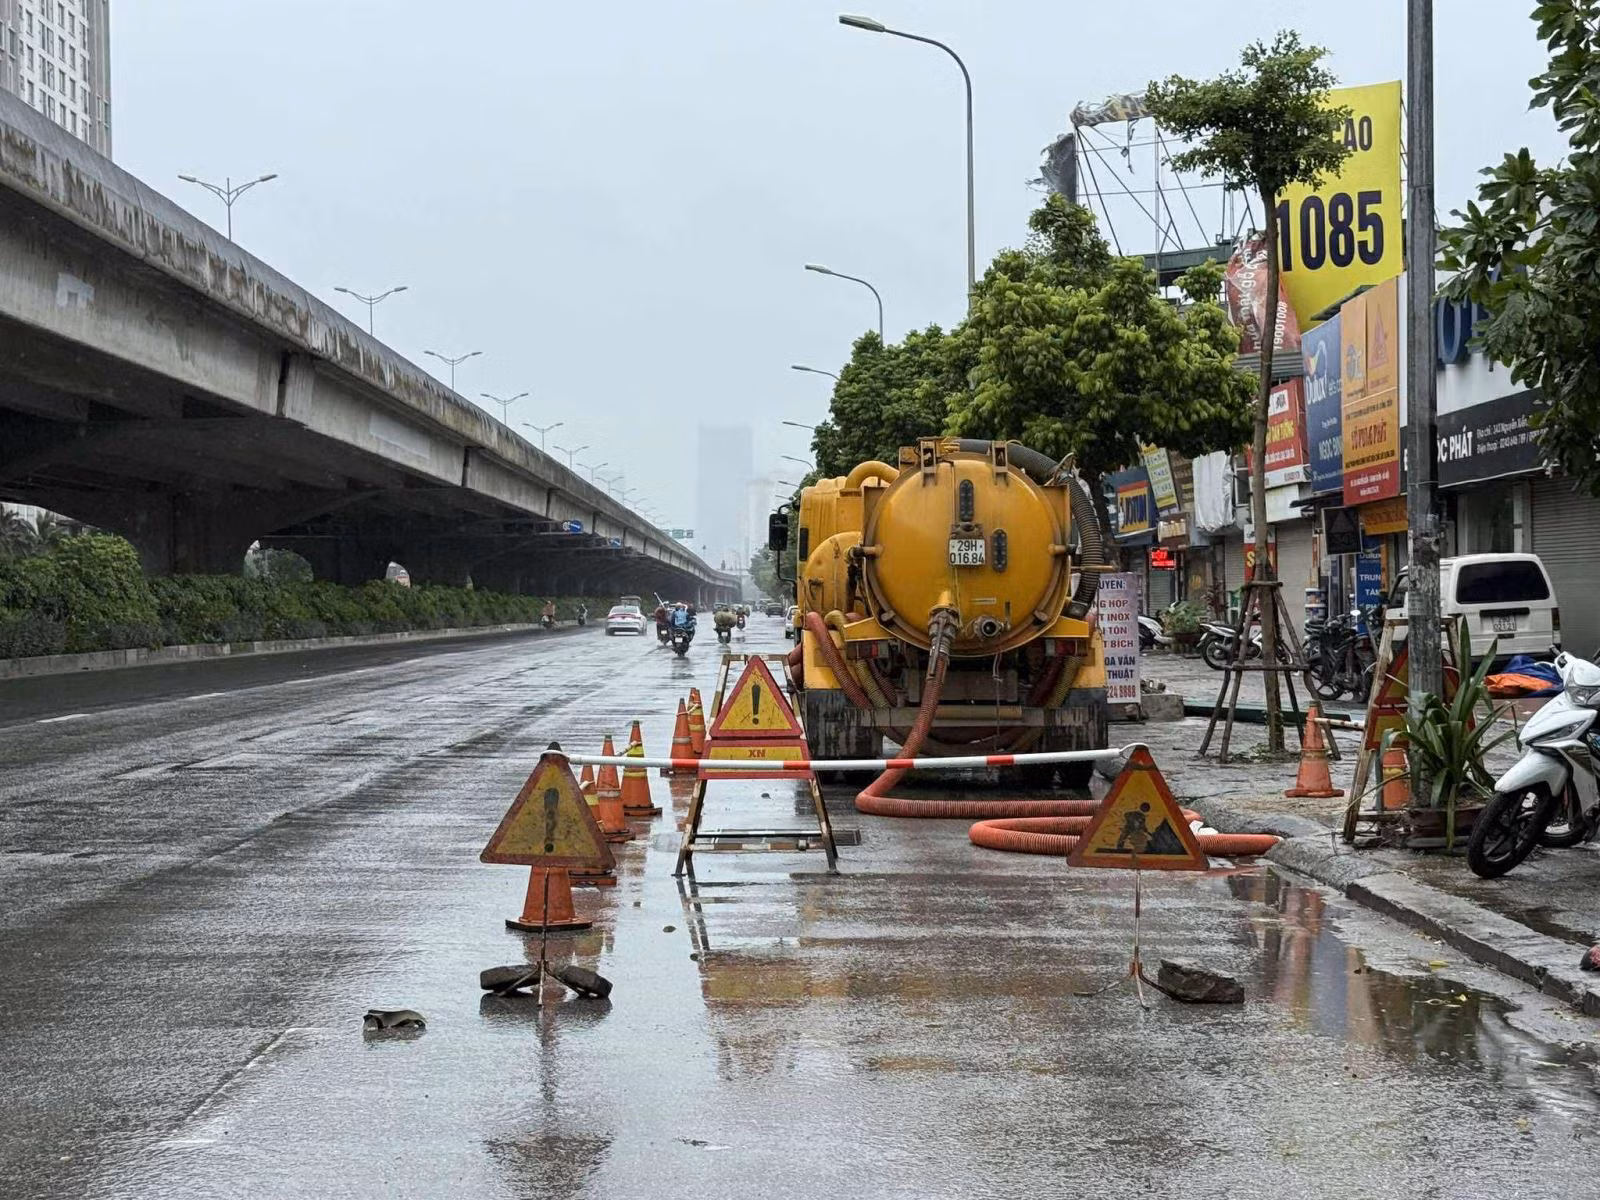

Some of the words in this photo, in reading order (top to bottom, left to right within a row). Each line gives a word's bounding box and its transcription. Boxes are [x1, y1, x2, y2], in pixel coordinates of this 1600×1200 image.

[1276, 190, 1384, 272] 1085
[1449, 425, 1473, 461] PHÁT
[957, 540, 977, 552] 29H
[1107, 613, 1130, 622] INOX
[1107, 667, 1134, 681] THUẬT
